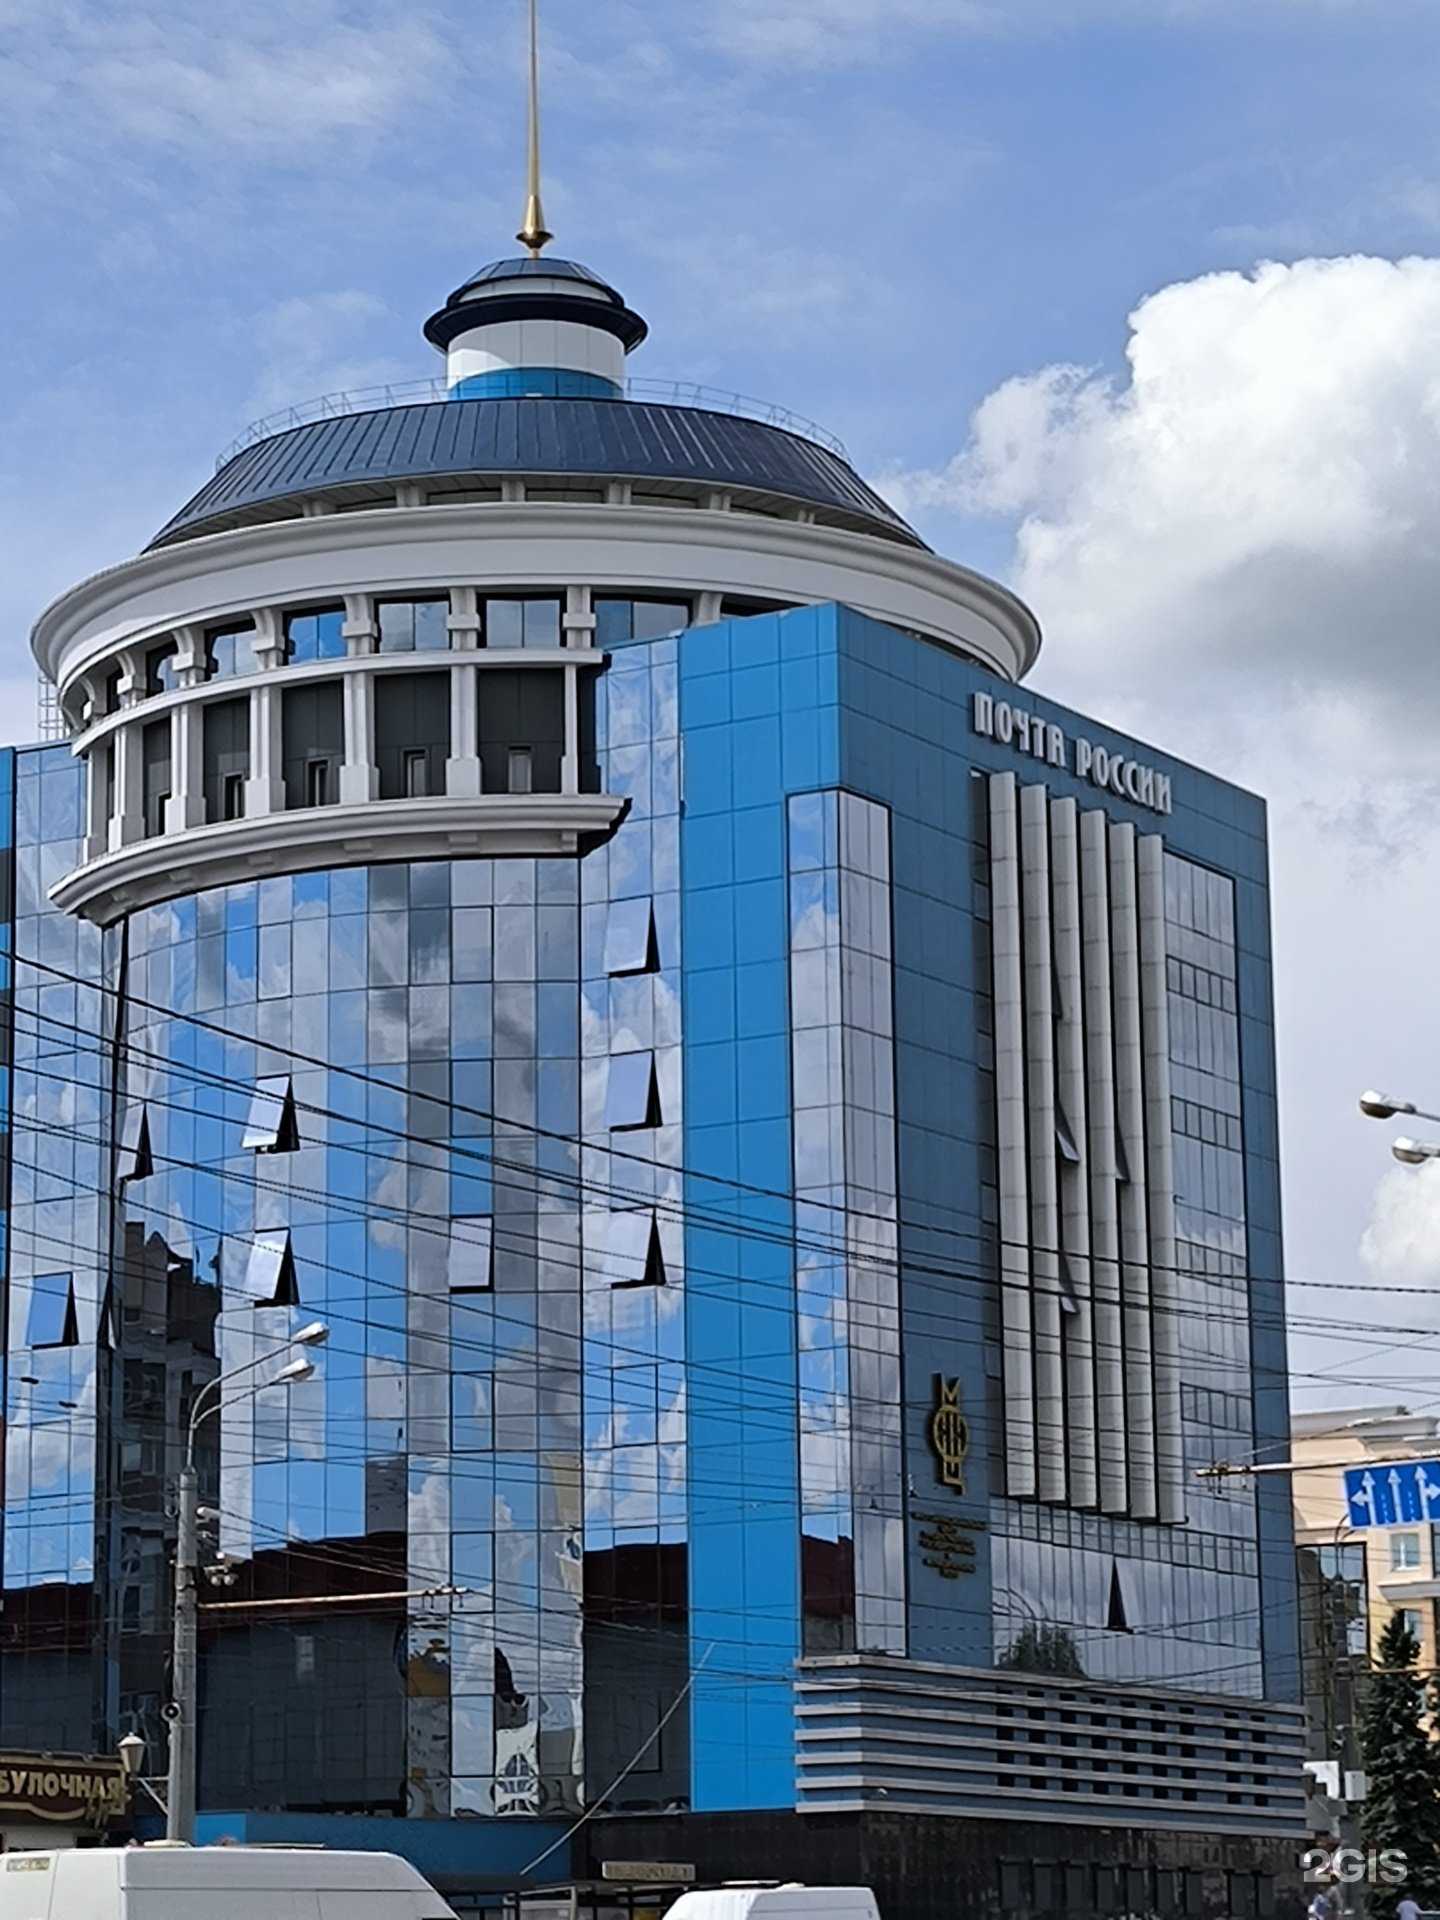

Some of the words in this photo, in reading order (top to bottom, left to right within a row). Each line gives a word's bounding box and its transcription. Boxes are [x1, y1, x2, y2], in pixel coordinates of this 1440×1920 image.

[974, 691, 1067, 768] ПОЧТА
[1076, 737, 1173, 815] РОССИИ
[0, 1769, 121, 1800] БУЛОЧНАЯ
